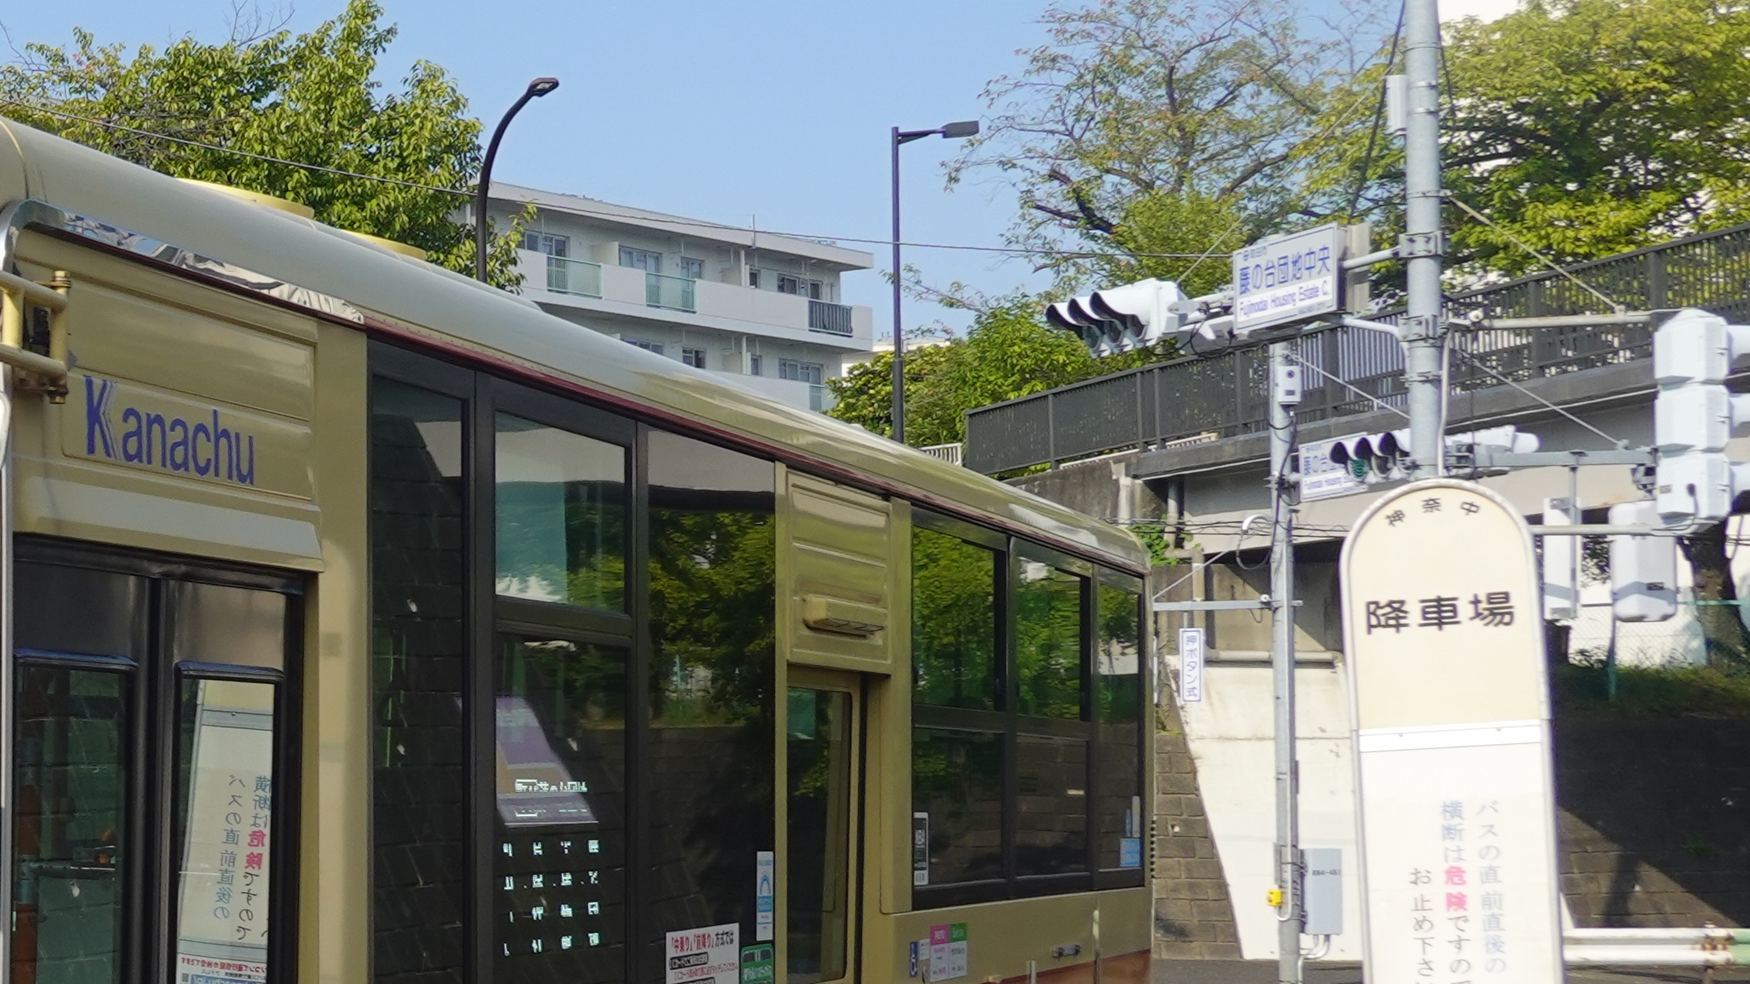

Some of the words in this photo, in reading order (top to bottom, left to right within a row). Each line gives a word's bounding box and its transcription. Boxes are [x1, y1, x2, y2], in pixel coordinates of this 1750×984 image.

[1239, 244, 1331, 296] 藤の台団地中央
[1271, 291, 1297, 307] Housing
[1299, 284, 1320, 302] Estate
[83, 374, 255, 486] Kanachu
[1385, 497, 1481, 527] 神奈中
[1365, 591, 1515, 635] 降車場
[1185, 634, 1198, 698] 押ボタン式
[1477, 800, 1507, 974] バスの直前直後の
